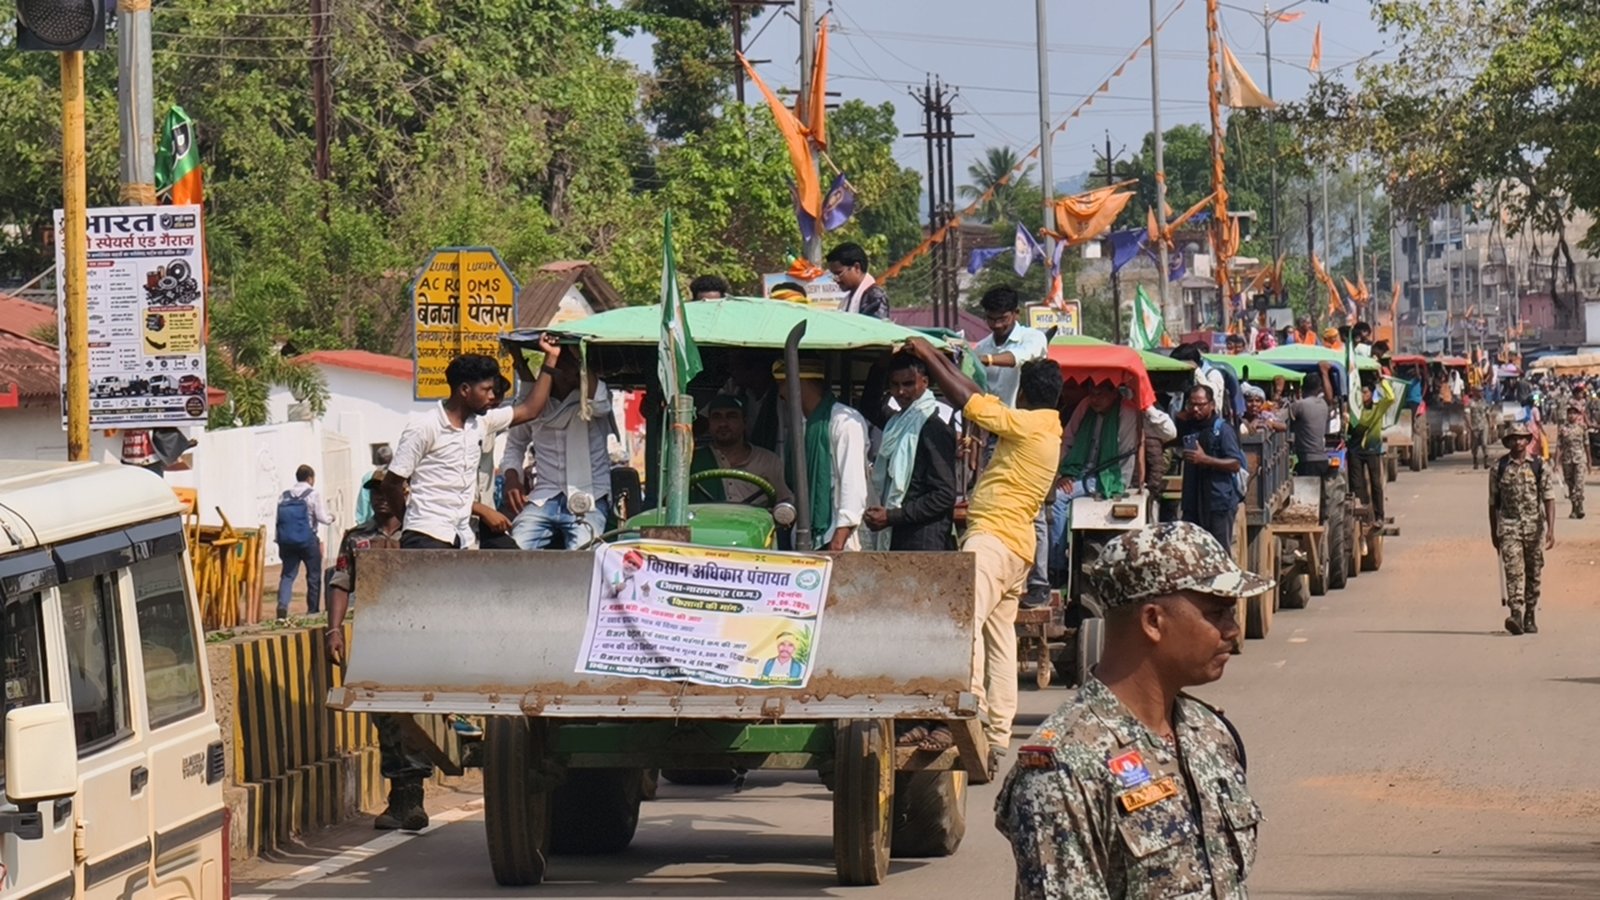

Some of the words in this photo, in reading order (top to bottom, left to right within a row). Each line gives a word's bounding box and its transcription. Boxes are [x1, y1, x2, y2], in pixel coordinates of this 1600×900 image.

[95, 233, 135, 249] स्पेयर्स
[137, 234, 156, 248] एंड
[160, 232, 195, 247] गैराज
[419, 277, 440, 291] AC
[647, 554, 690, 577] किसान
[692, 561, 744, 584] अधिकार
[747, 566, 792, 586] पंचायत
